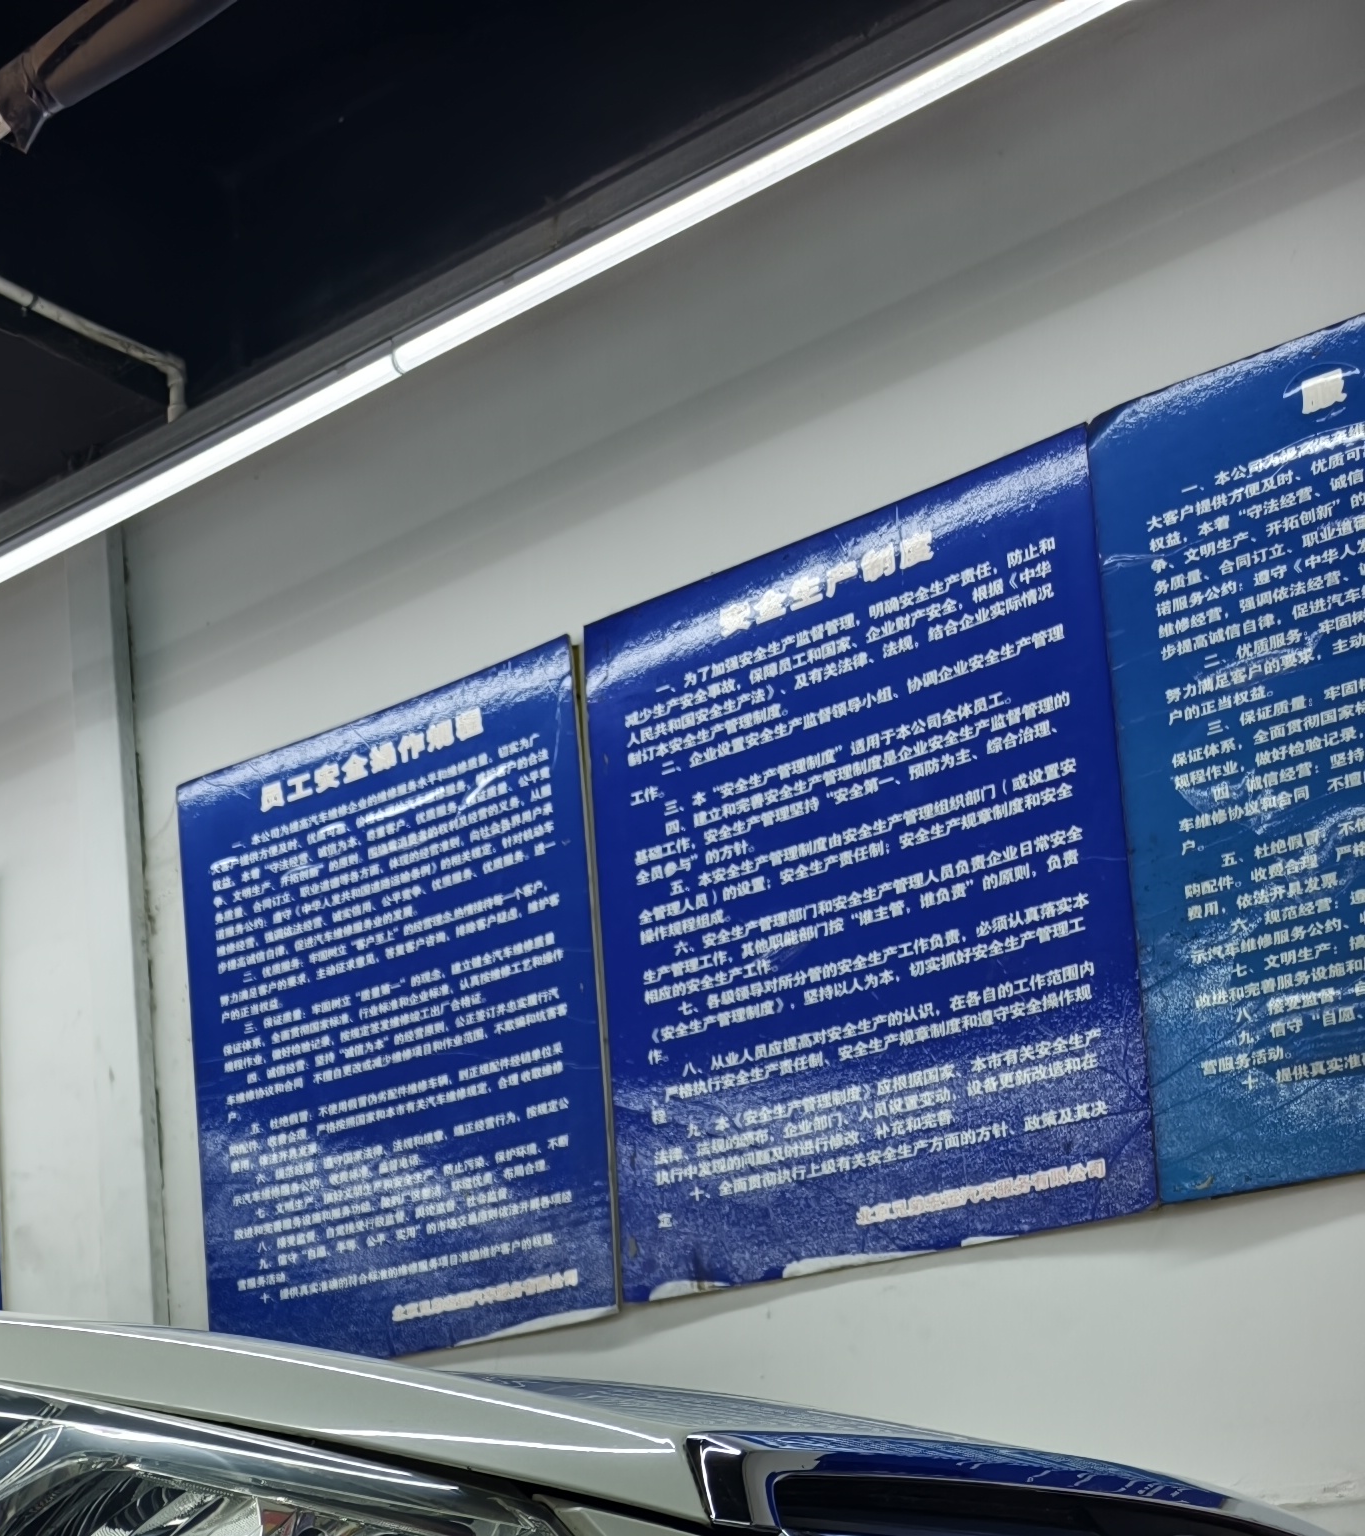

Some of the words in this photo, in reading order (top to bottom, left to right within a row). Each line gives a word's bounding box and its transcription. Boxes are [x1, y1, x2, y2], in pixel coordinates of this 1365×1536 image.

[1146, 442, 1365, 533] 大客户提供方便及时、优质可
[719, 526, 934, 640] 安全生产制度
[1168, 681, 1273, 726] 户的正当权益。
[259, 705, 484, 815] 员工安全操作规程
[627, 698, 788, 771] 制订本安全生产管理制度。
[630, 782, 664, 808] 工作。
[1327, 769, 1365, 793] 不擅
[1181, 837, 1204, 855] 户。
[640, 905, 730, 947] 操作规程组成。
[1191, 909, 1365, 965] 示汽车维修服务公约、
[644, 955, 778, 1008] 相应的安全生产工作。
[1195, 956, 1365, 1009] 改进和完善服务设施和
[648, 1046, 669, 1066] 作。
